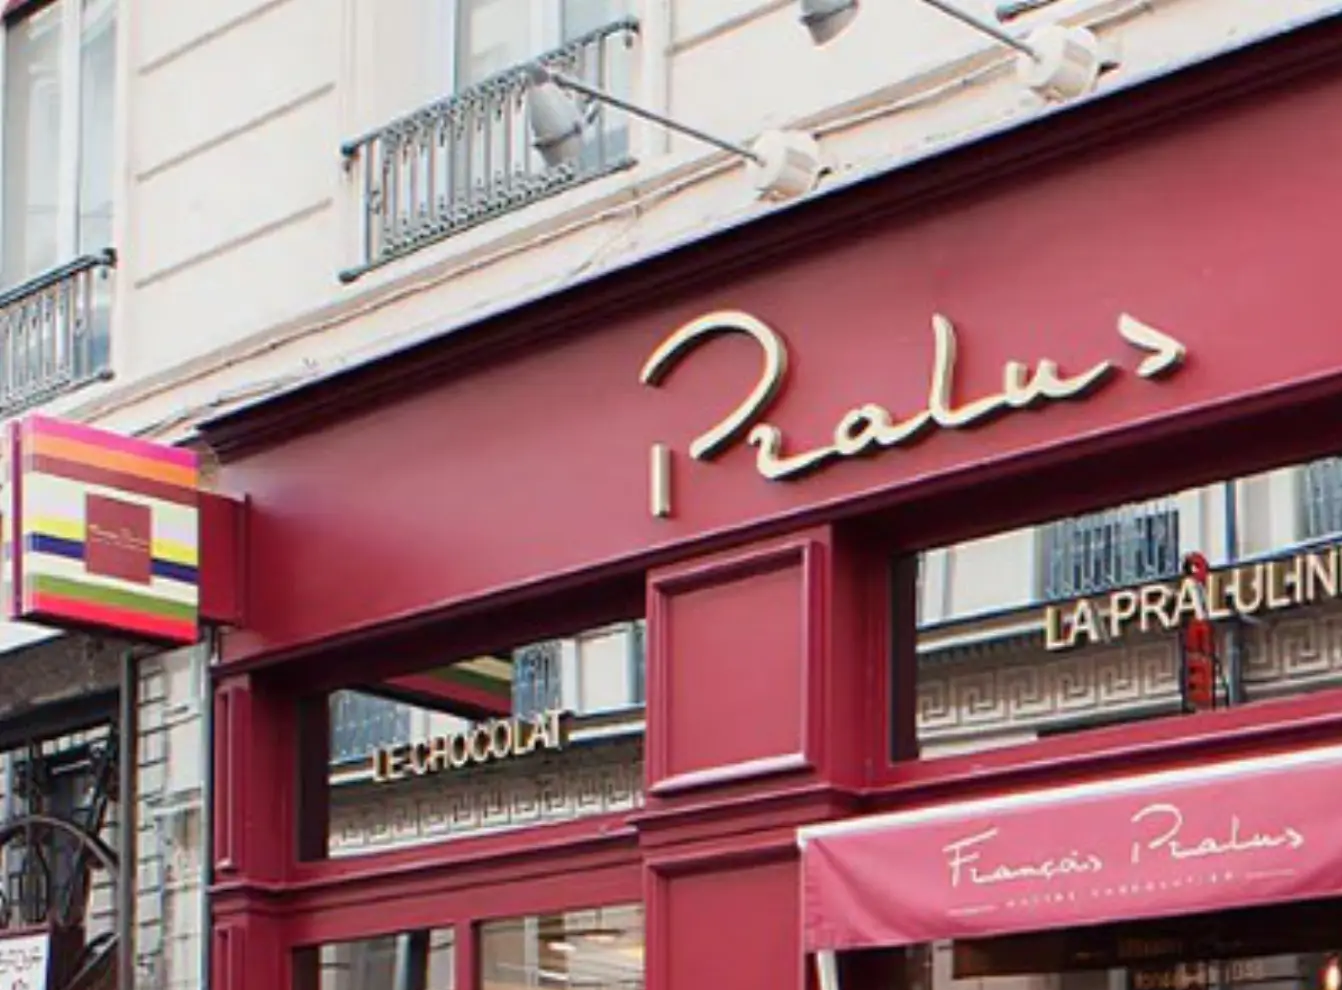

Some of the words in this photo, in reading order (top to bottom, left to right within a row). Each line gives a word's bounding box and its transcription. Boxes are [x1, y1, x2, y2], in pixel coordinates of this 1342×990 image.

[640, 309, 1188, 519] Pralus
[1045, 597, 1100, 651] LA
[372, 742, 407, 783] LE
[410, 708, 565, 776] CHOCOLAT
[942, 827, 1103, 887] François
[1130, 803, 1304, 864] Pralus
